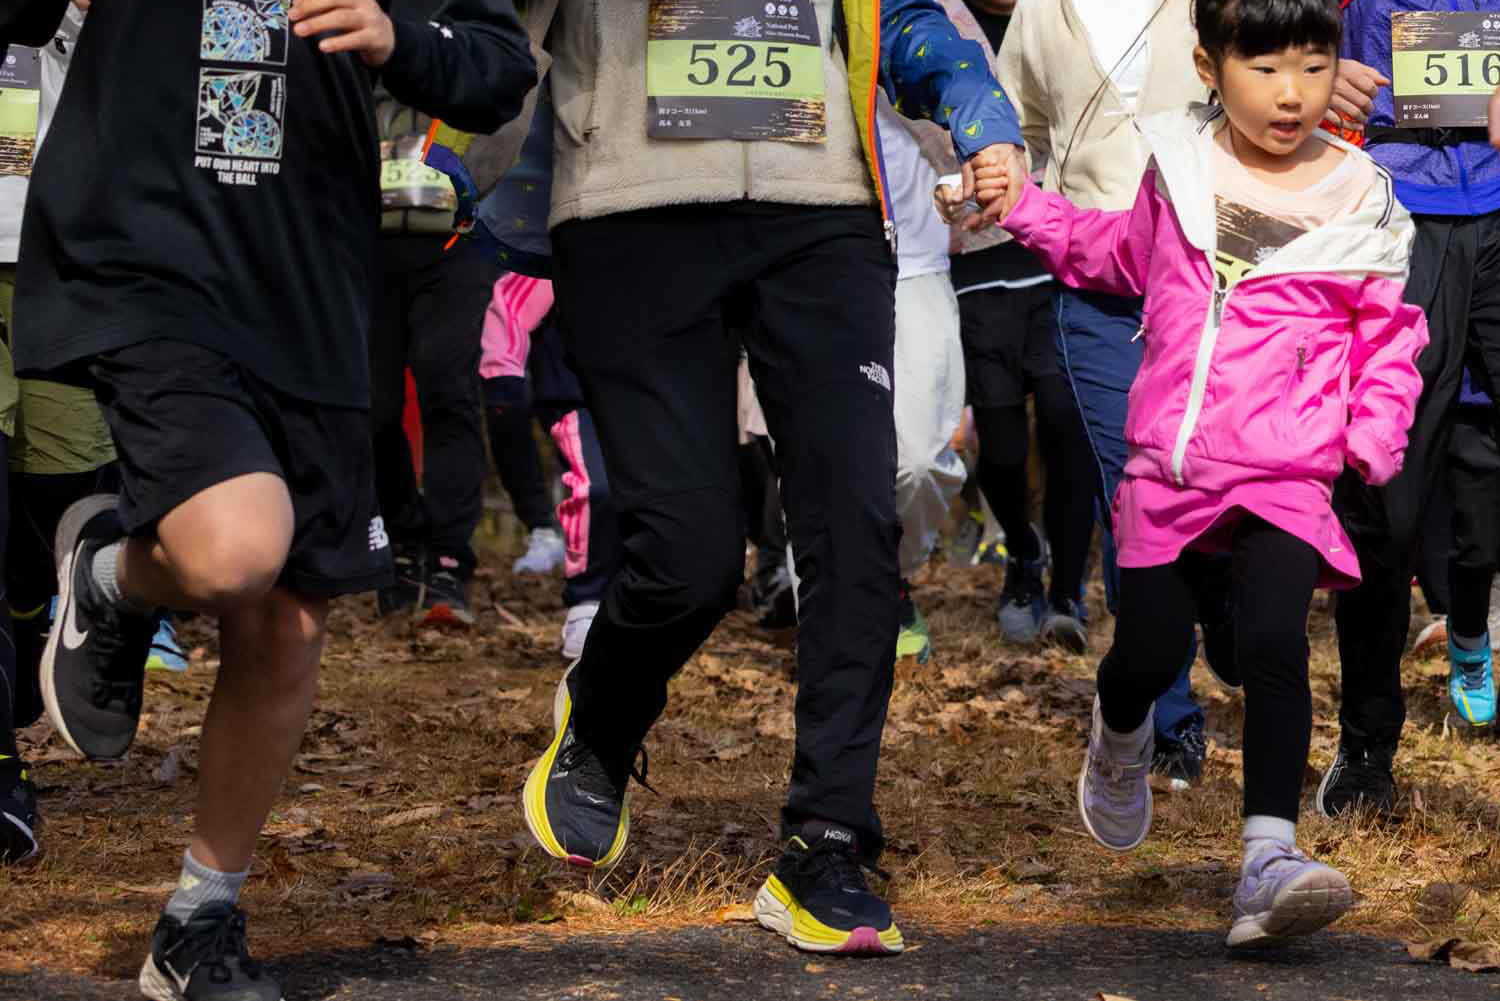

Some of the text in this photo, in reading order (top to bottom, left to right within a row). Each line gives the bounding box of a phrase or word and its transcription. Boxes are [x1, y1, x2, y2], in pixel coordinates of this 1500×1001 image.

[688, 43, 791, 88] 525
[194, 155, 212, 168] PUT
[232, 159, 260, 173] HEART
[217, 171, 257, 186] THE BALL
